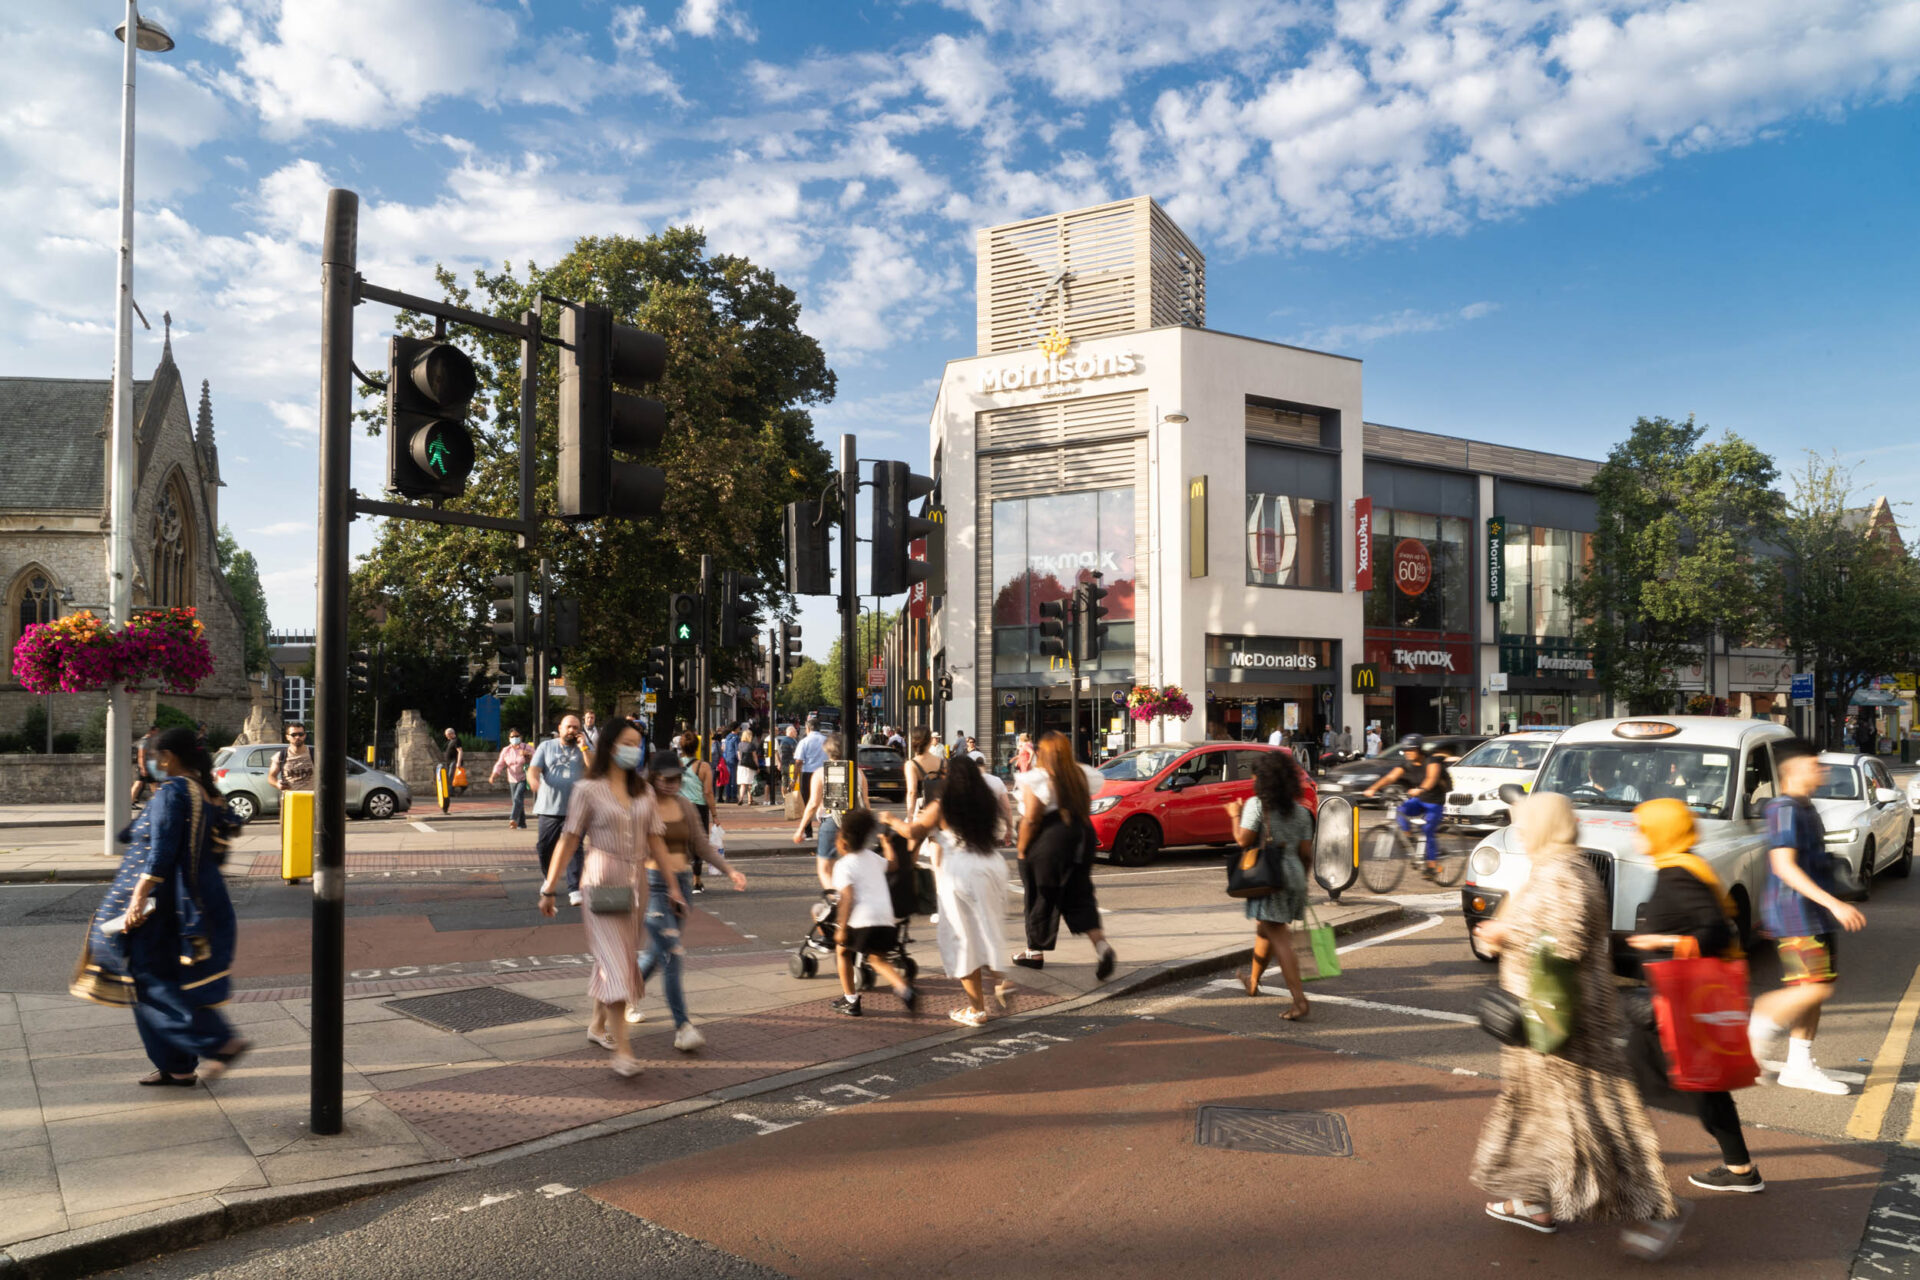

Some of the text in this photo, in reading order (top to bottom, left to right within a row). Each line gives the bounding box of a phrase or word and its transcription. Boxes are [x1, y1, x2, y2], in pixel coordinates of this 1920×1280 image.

[977, 352, 1136, 393] Morrisons
[1490, 538, 1500, 598] Morrisons
[1231, 652, 1317, 668] McDonald's
[1537, 655, 1593, 670] Morrisons
[351, 962, 462, 979] OOK
